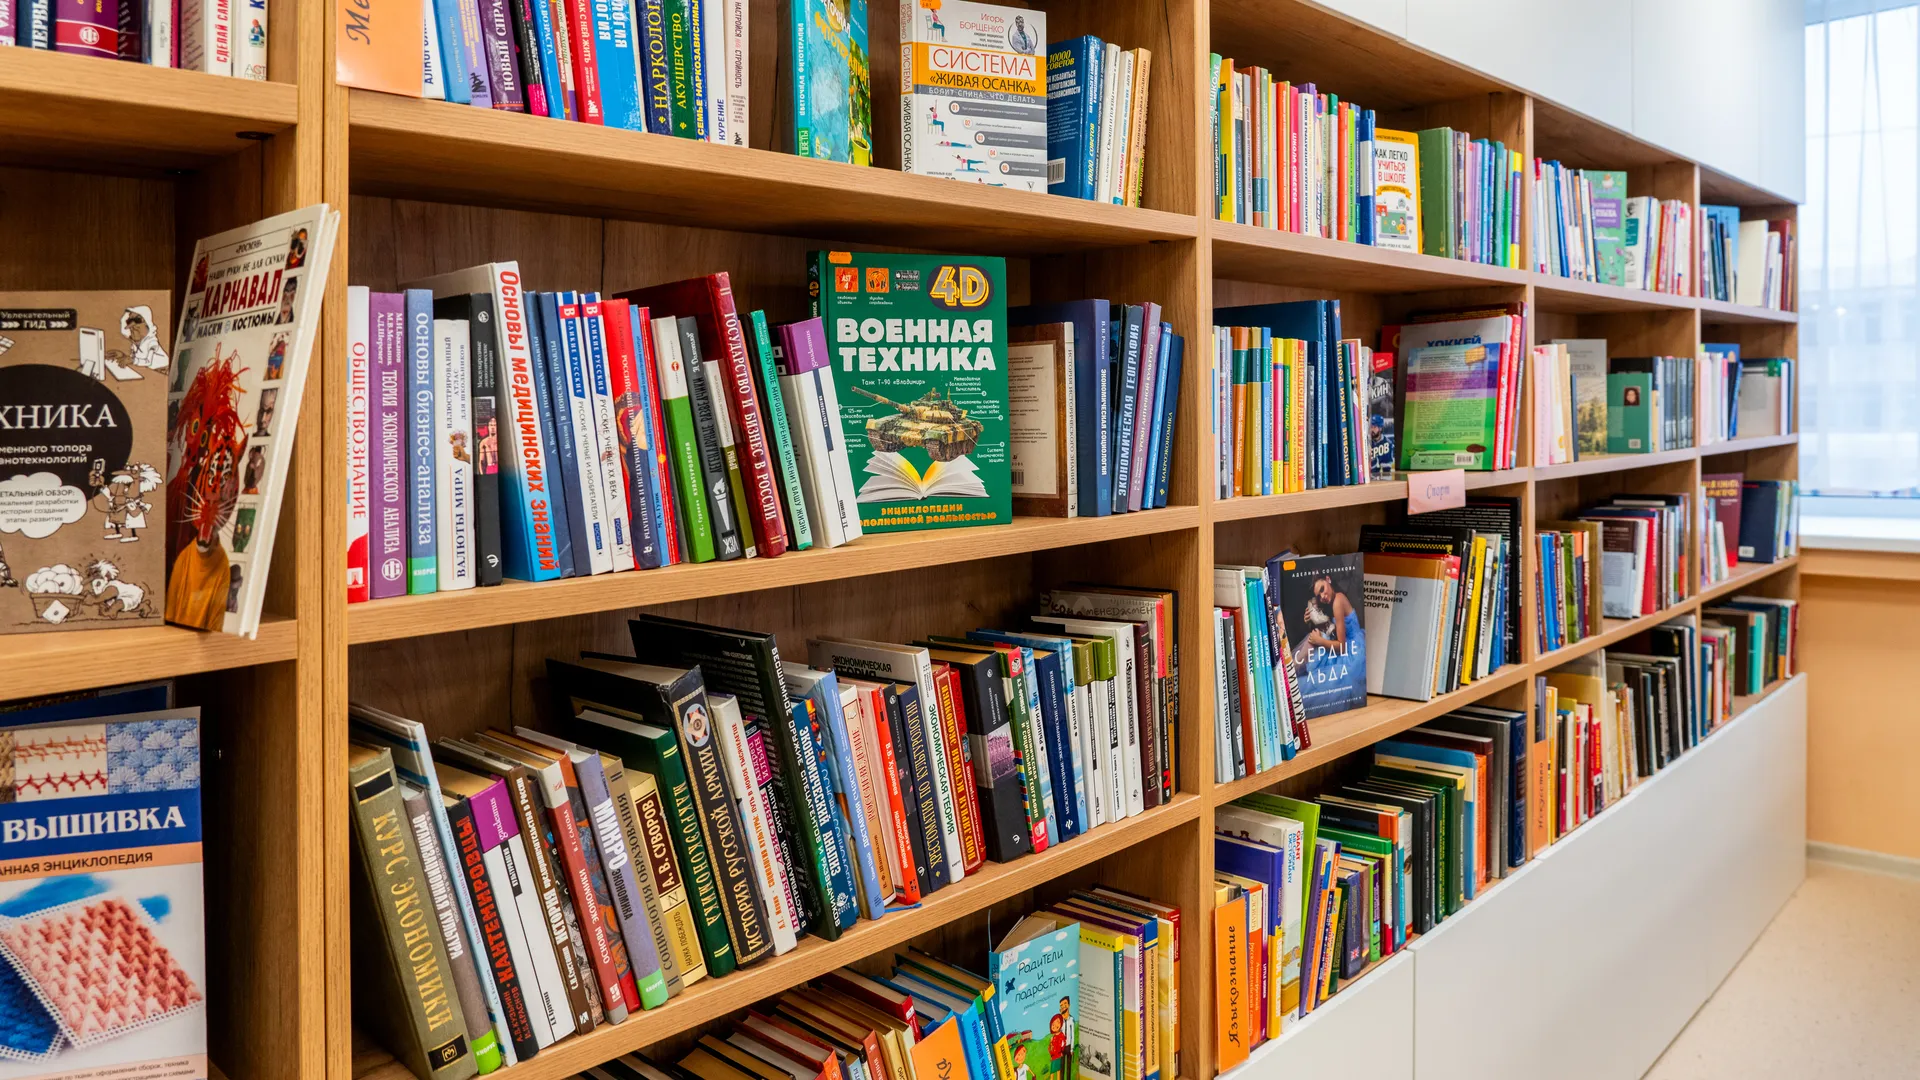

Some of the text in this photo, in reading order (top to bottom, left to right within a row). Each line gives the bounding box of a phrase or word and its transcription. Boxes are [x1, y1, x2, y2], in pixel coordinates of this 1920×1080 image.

[537, 9, 557, 55] ВОЗРАСТА
[734, 1, 742, 37] НАСТРОЙСЯ
[960, 20, 1004, 34] БОРЩЕНКО
[981, 13, 1004, 25] Игорь
[215, 23, 228, 62] СДЕЛАЙ
[581, 37, 591, 63] ЖИТЬ
[669, 12, 688, 108] АКУШЕРСТВО
[932, 48, 1032, 77] СИСТЕМА
[495, 39, 514, 91] НОВЫЙ
[734, 49, 742, 88] СТРОЙНОСТЬ
[902, 46, 910, 90] СИСТЕМА
[1209, 63, 1220, 100] ШКОЛЕ
[696, 99, 704, 135] СЕМЬЕ
[716, 98, 725, 139] КУРЕНИЕ
[1008, 96, 1036, 104] ДЕЛАТЬ
[1378, 160, 1406, 172] УЧИТЬСЯ
[1388, 150, 1408, 161] ЛЕГКО
[1378, 172, 1406, 184] В ШКОЛЕ
[242, 252, 286, 272] НЕ СКУКИ
[201, 269, 283, 319] КАРНАВАЛ
[930, 266, 993, 306] 4D
[23, 320, 46, 328] ГИД
[198, 312, 276, 338] МАСКИ КОСТЮМЫ
[837, 318, 992, 343] ВОЕННАЯ
[1426, 334, 1482, 348] ХОККЕЙ
[803, 329, 819, 367] gaudeamus
[838, 347, 996, 372] ТЕХНИКА
[1336, 339, 1344, 381] РОССИИ
[444, 336, 452, 428] ИЛЛЮСТРИРОВАННЫЙ
[539, 372, 549, 408] ПОИСКАХ
[571, 356, 582, 393] РУССКИЕ
[593, 354, 604, 390] РУССКИЕ
[555, 375, 565, 412] ПОИСКАХ
[1117, 324, 1139, 495] ЭКОНОМИЧЕСКАЯ ГЕОГРАФИЯ
[349, 342, 369, 519] ОБЩЕСТВОЗНАНИЕ
[498, 269, 559, 570] Основы медицинских знаний
[598, 399, 609, 433] РУССКИЕ
[691, 376, 722, 474] ЛЕГЕНДАРНЫЕ РАЗВЕДЧИКИ
[723, 311, 776, 520] ГОСУДАРСТВО И БИЗНЕС В РОССИИ
[51, 444, 92, 454] топора
[382, 370, 399, 554] ТЕОРИЯ ЭКОНОМИЧЕСКОГО АНАЛИЗА
[576, 401, 598, 520] РУССКИЕ ИЗОБРЕТАТЕЛИ
[763, 351, 807, 535] НАУЧНОЕ МИРОВОЗЗРЕНИЕ ИЗМЕНИТ ВАШУ ЖИЗНЬ
[1341, 427, 1350, 478] ПОЧТОВЫЕ
[416, 390, 432, 545] бизнес-анализа
[685, 441, 698, 496] КУЛЬТУРОЛОГИЯ
[45, 487, 74, 497] ОБЗОР:
[1426, 484, 1450, 500] Спорт
[454, 467, 465, 577] ВАЛЮТЫ МИРА
[638, 496, 650, 539] МЕЦЕНАТЫ
[1292, 566, 1356, 578] АДЕЛИНА СОТНИКОВА
[1251, 635, 1261, 667] ФУТБОЛ
[1257, 629, 1265, 667] ПЛАВАНИЕ
[1261, 634, 1272, 666] ХОККЕЙ
[1269, 625, 1280, 656] ЖЕНЩИН
[1295, 640, 1358, 664] СЕРДЦЕ
[831, 653, 892, 673] ЭКОНОМИЧЕСКАЯ
[1306, 665, 1348, 684] ЛЬДА
[940, 683, 957, 744] ЭКОНОМИКИ
[742, 767, 758, 813] ПУТЬ НОВОЕ
[787, 720, 821, 842] ОРУЖИЕ СПЕЦАГЕНТОВ
[903, 699, 943, 868] ХРЕСТОМАТИЯ ПО КУЛЬТУРОЛОГИИ
[927, 704, 955, 835] ЭКОНОМИЧЕСКАЯ ТЕОРИЯ
[950, 748, 965, 792] ИСТОРИЯ
[487, 796, 508, 840] gaudeamus
[798, 727, 842, 876] ЭКОНОМИЧЕСКИЙ АНАЛИЗ
[2, 805, 186, 843] ВЫШИВКА
[641, 798, 674, 887] А. В. СУВОРОВ
[958, 795, 976, 860] ПОПУЛЯРНАЯ
[43, 852, 153, 872] ЭНЦИКЛОПЕДИЯ
[670, 780, 723, 926] МАКРОЭКОНОМИКА
[696, 744, 765, 951] ИСТОРИЯ РУССКОЙ АРМИИ
[765, 783, 805, 918] ЭКСТРЕМАЛЬНОЙ СИТУАЦИИ
[408, 814, 465, 959] ОРГАНИЗАЦИОННАЯ КУЛЬТУРА
[456, 814, 514, 983] КАНТЕМИРОВЦЫ
[616, 791, 674, 970] СОЦИОЛОГИЯ ОБРАЗОВАНИЯ
[370, 808, 454, 1032] КУРС ЭКОНОМИКИ
[542, 887, 570, 943] ИСТОРИЯ
[576, 868, 611, 963] ОСНОВЫ ЭКОНОМИКИ
[672, 910, 692, 965] НАУКА ПОБЕЖДАТЬ
[1018, 950, 1064, 976] Родители
[1015, 974, 1066, 1002] подростки
[1225, 924, 1240, 1047] Языкознание
